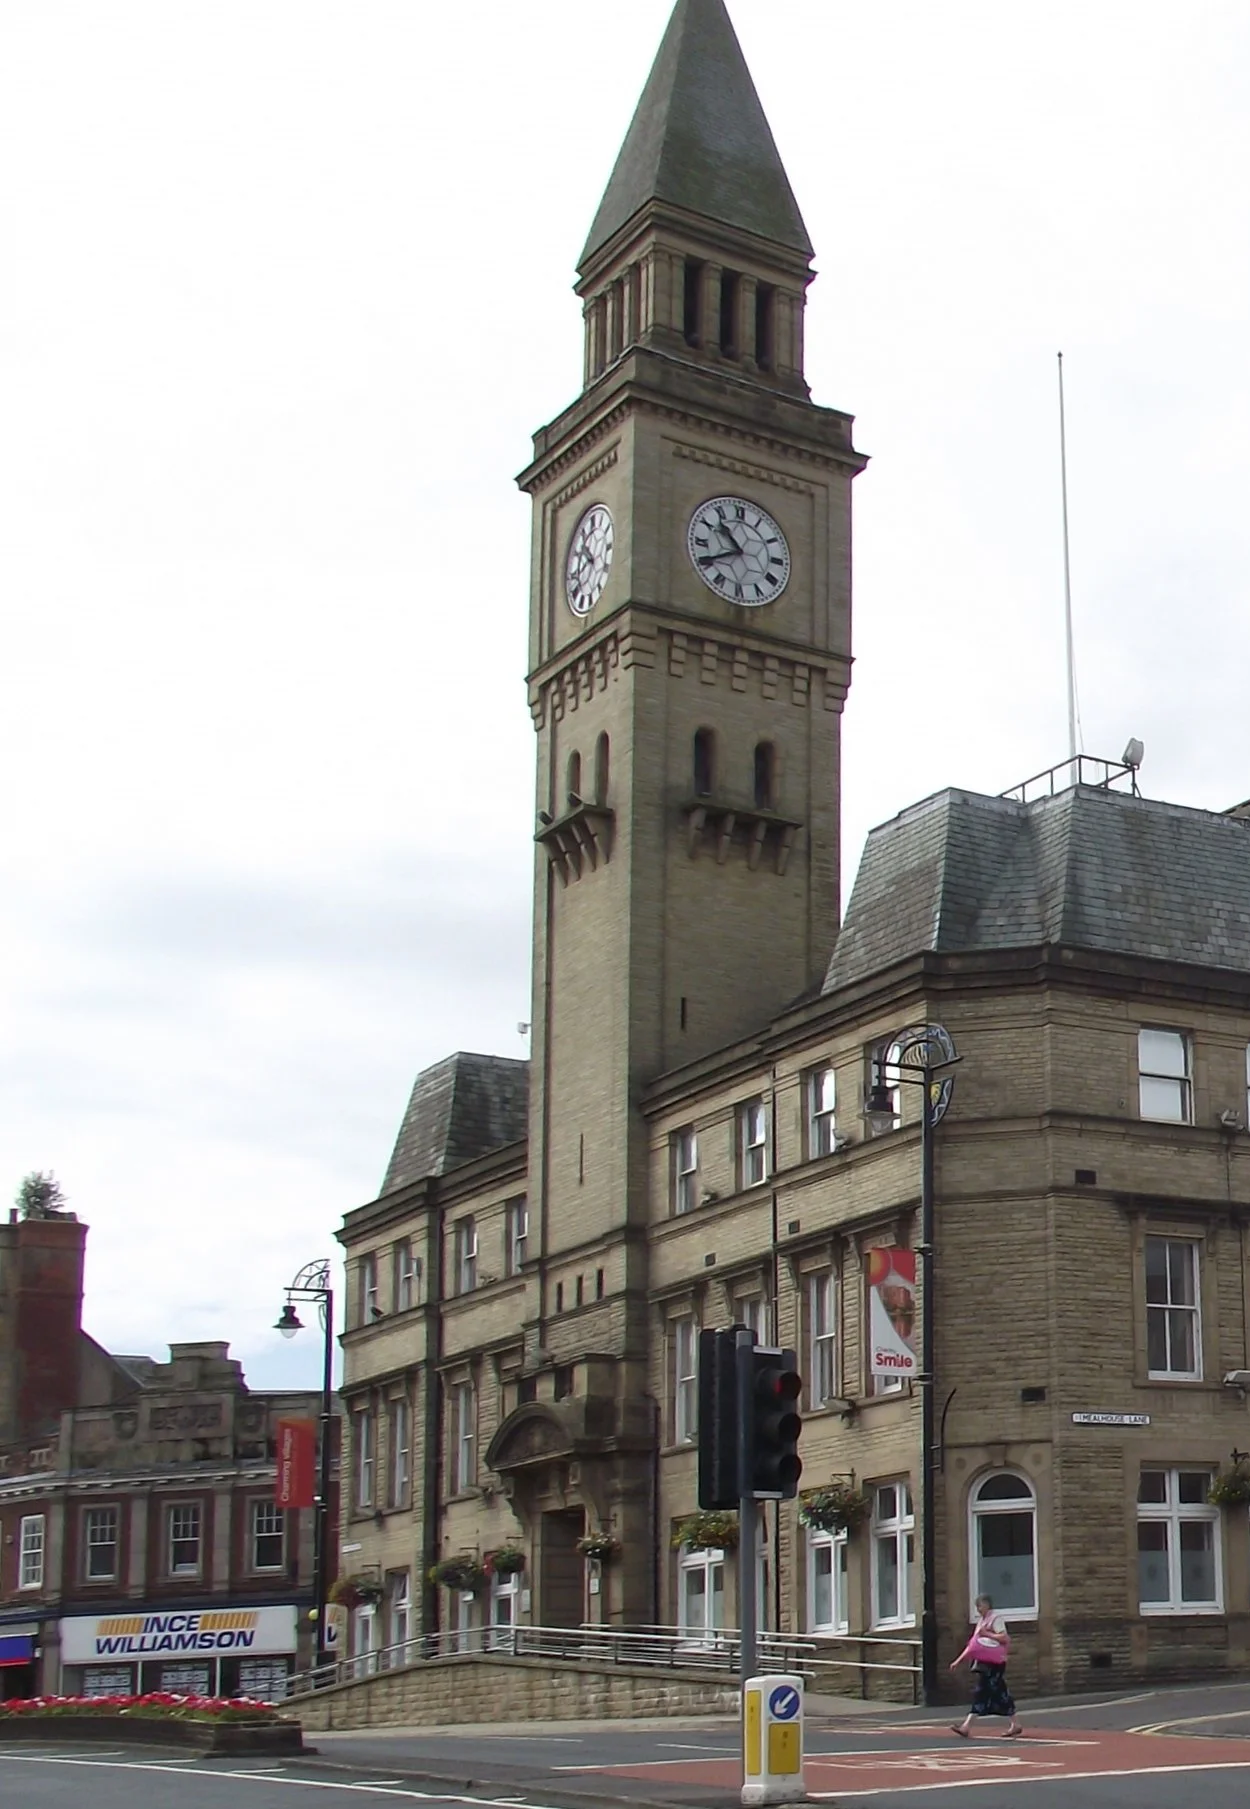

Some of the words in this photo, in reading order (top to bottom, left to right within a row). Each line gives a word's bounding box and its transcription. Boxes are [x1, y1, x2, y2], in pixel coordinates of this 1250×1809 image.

[875, 1353, 913, 1368] Smile
[1082, 1414, 1124, 1422] MEALHOUSE
[1129, 1416, 1147, 1424] LANE
[281, 1461, 291, 1501] Charming
[143, 1614, 200, 1634] INCE
[95, 1630, 255, 1654] WILLIAMSON
